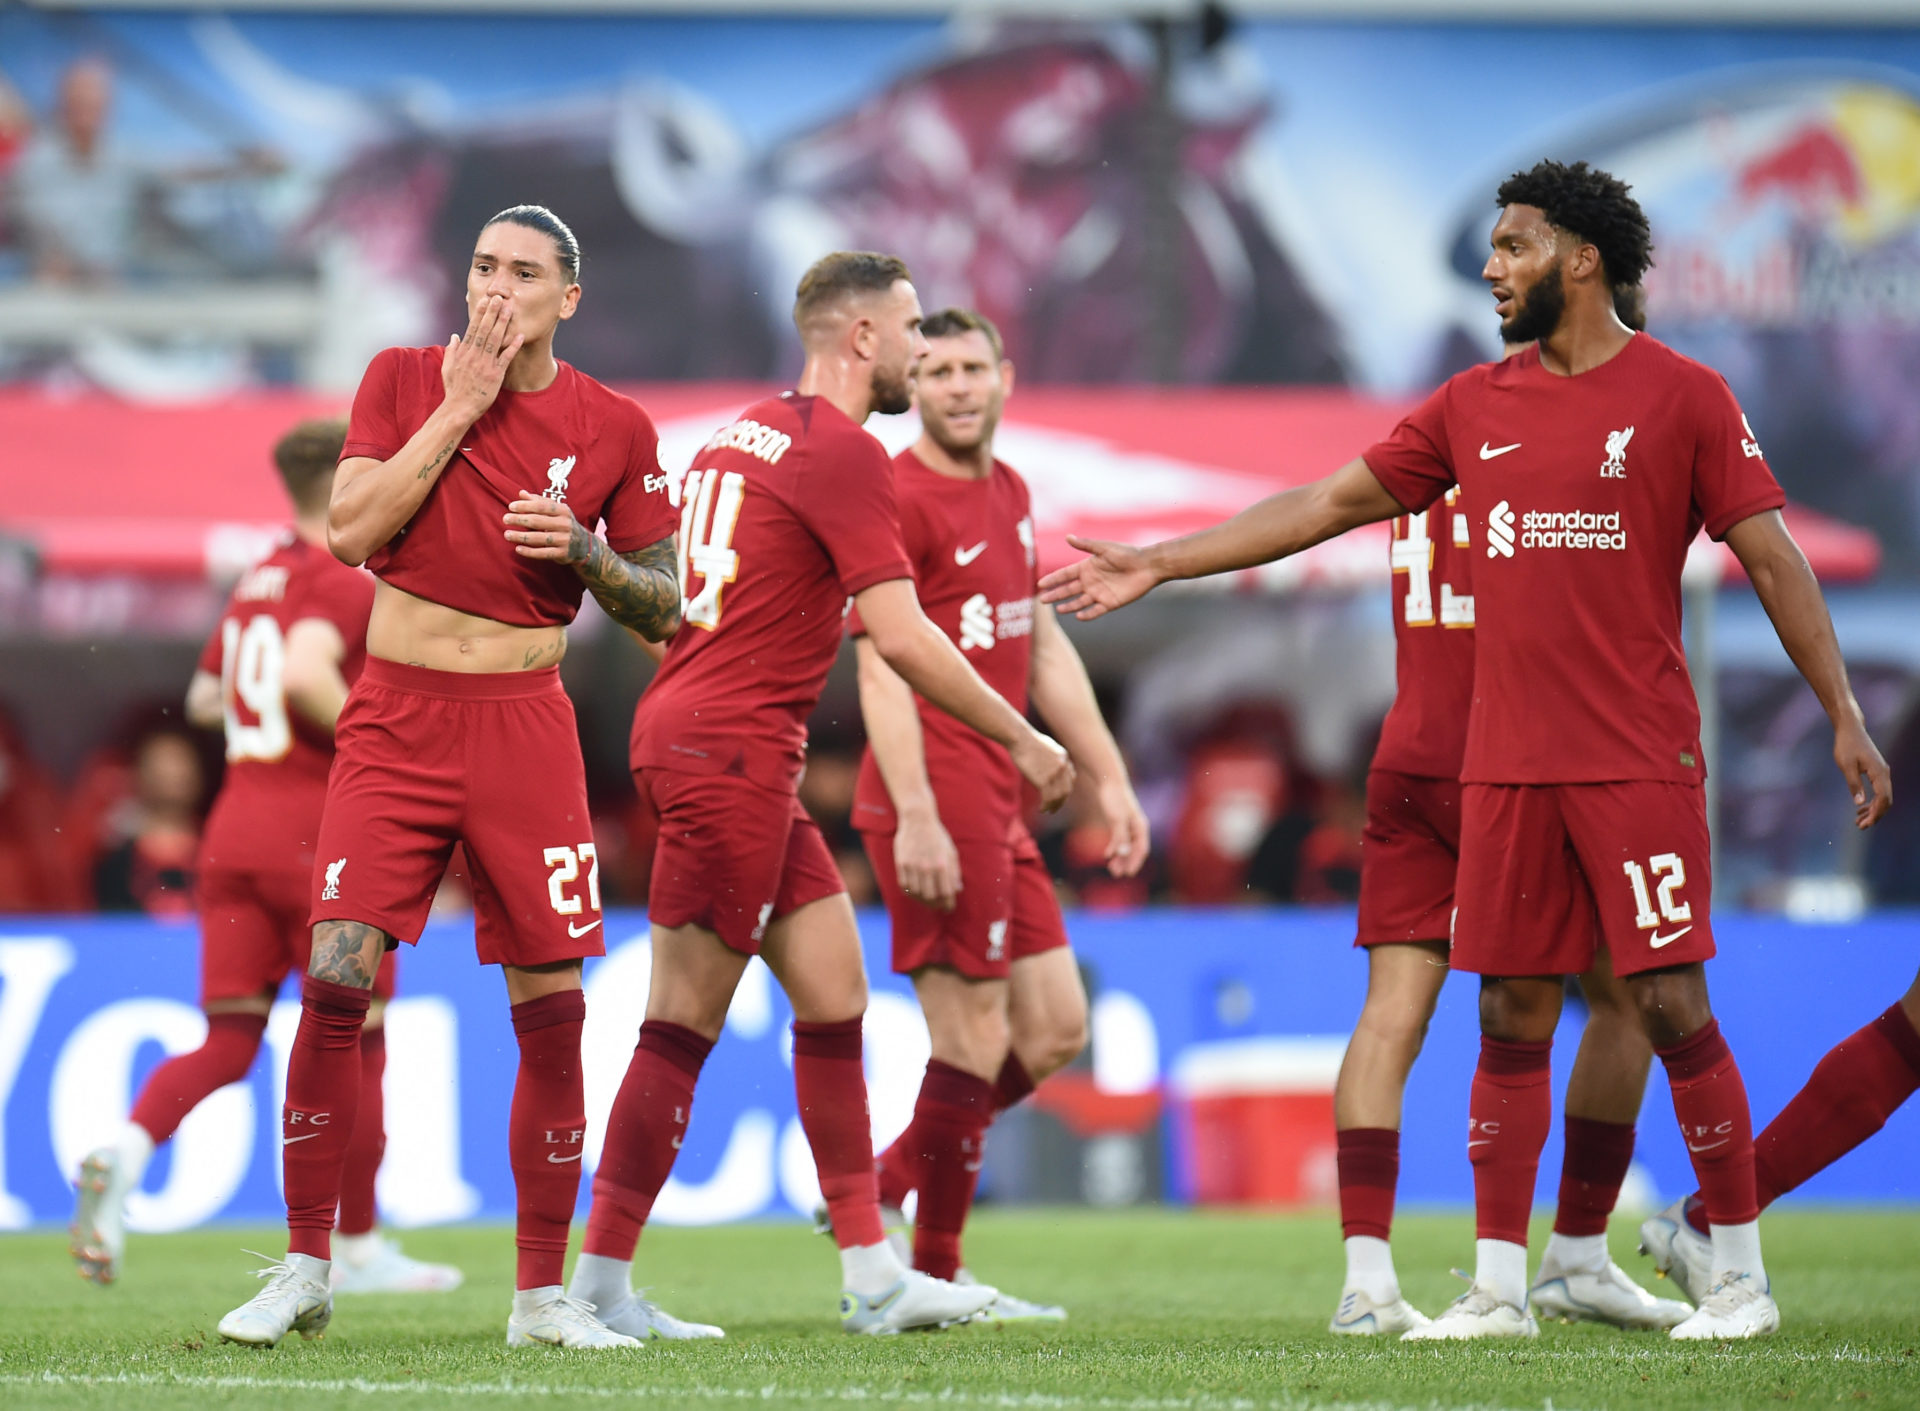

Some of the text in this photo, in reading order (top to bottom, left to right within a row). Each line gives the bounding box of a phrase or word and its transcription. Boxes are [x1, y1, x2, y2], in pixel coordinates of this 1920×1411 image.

[1521, 509, 1620, 531] standard
[1521, 529, 1627, 551] chartered
[221, 612, 296, 765] 19
[543, 842, 601, 916] 27
[1623, 852, 1692, 930] 12
[283, 1110, 331, 1126] FC
